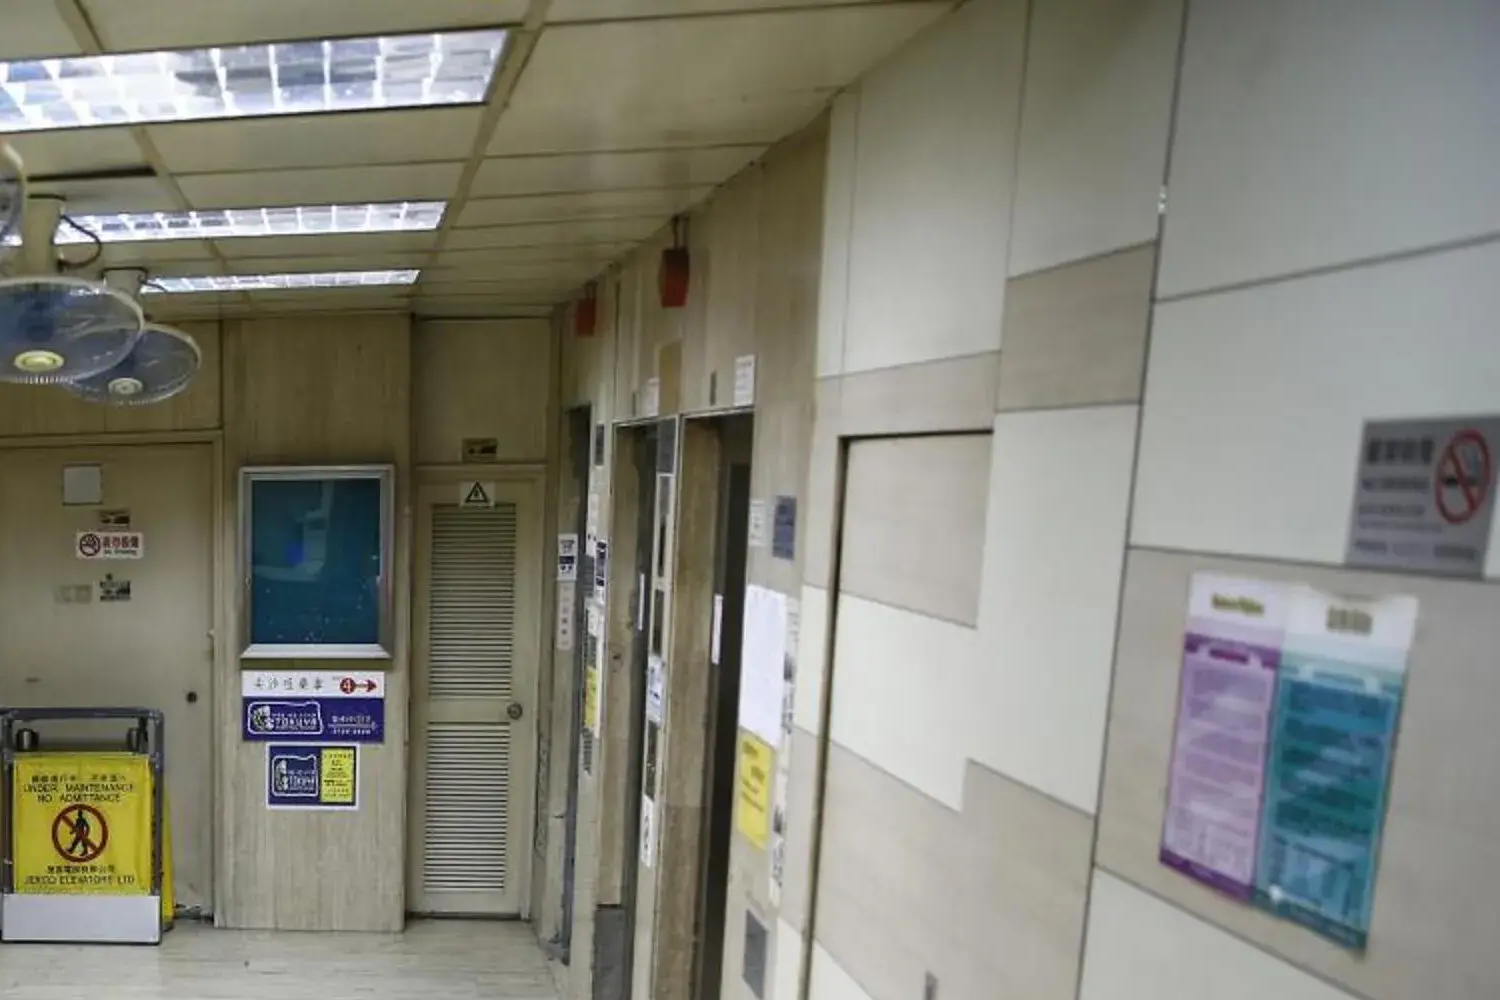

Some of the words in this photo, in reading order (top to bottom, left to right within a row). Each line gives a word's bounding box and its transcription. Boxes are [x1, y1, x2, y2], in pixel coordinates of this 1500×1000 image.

[23, 783, 58, 793] UNDER
[65, 783, 134, 793] MAINTENANCE
[37, 794, 53, 803] NO
[59, 794, 121, 803] ADMITTANCE
